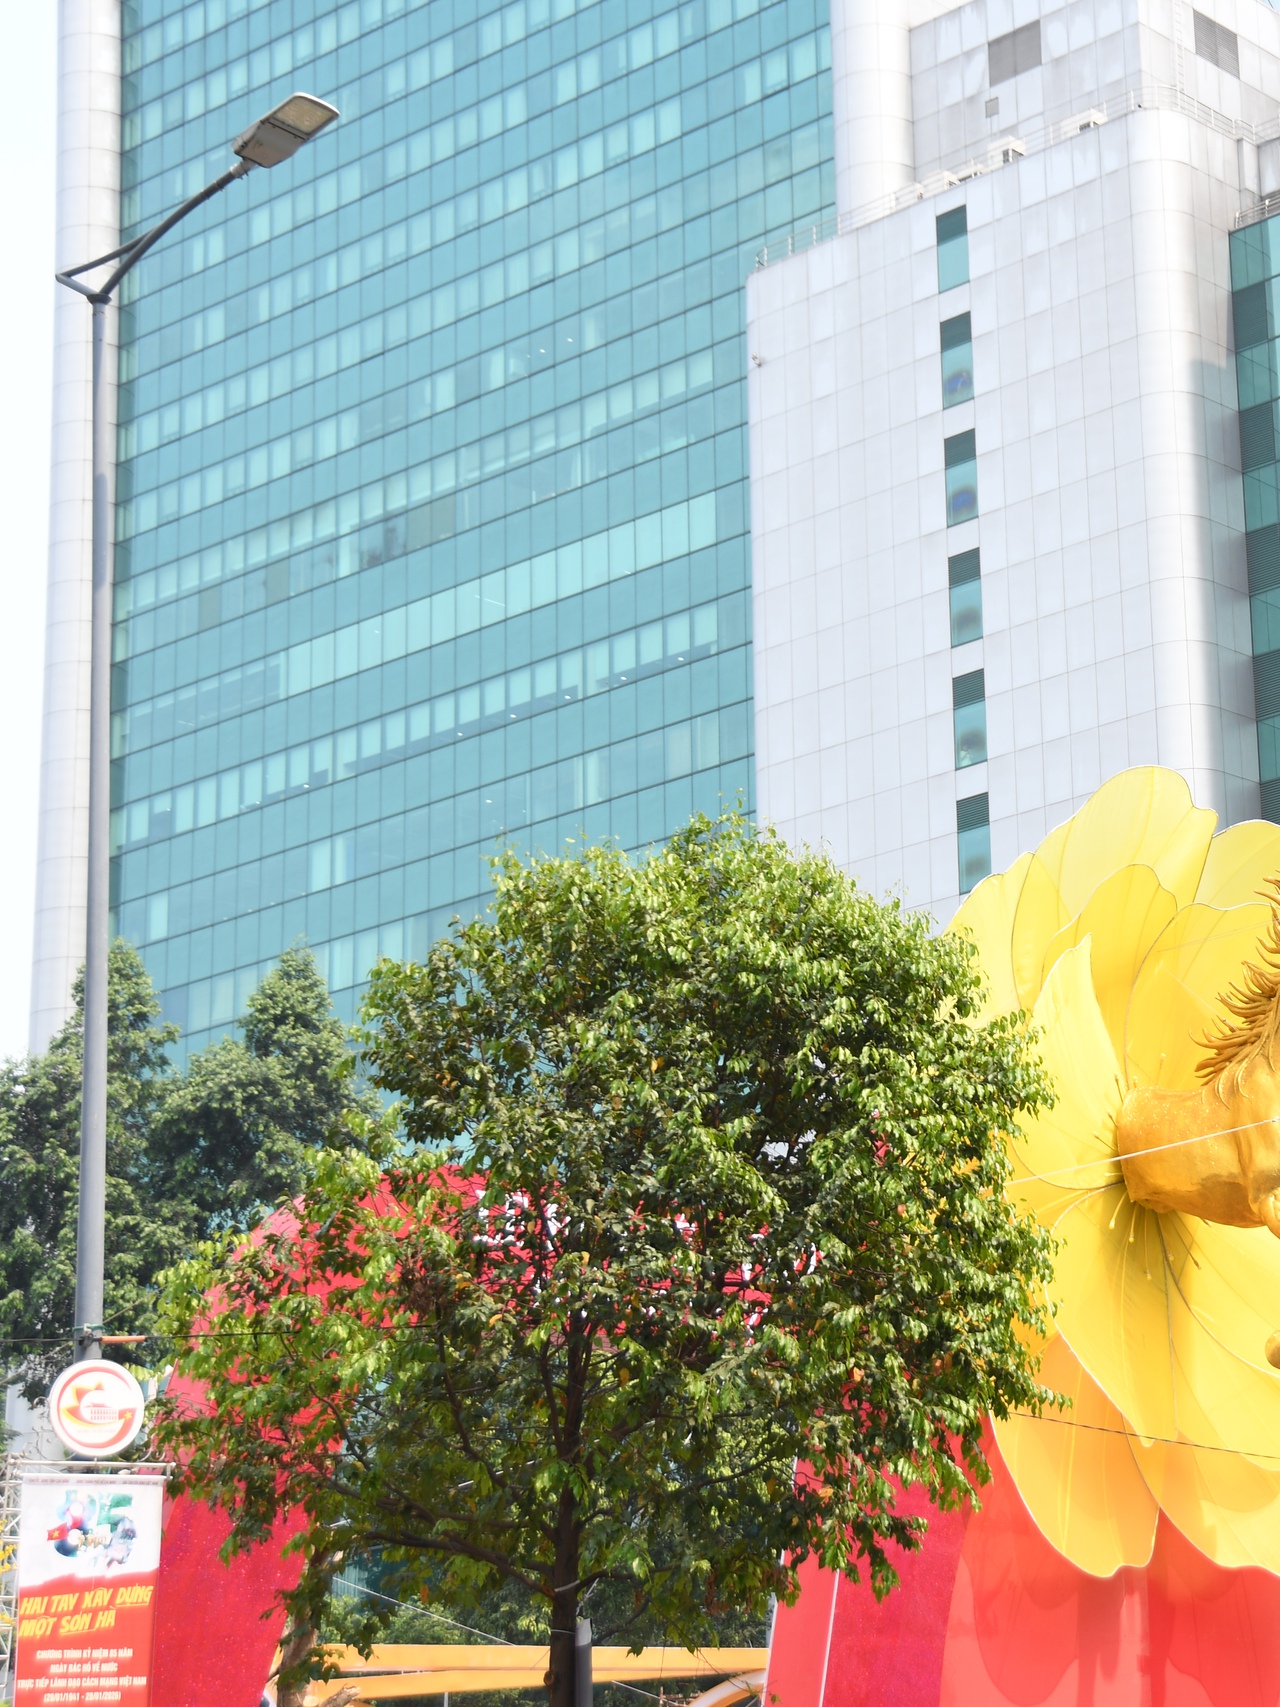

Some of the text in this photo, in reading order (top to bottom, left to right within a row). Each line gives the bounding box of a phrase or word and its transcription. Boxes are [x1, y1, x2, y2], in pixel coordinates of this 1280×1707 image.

[20, 1583, 154, 1615] HAI TAY XÂY DỰNG
[18, 1615, 58, 1639] MỘT
[59, 1611, 94, 1635] SƠN
